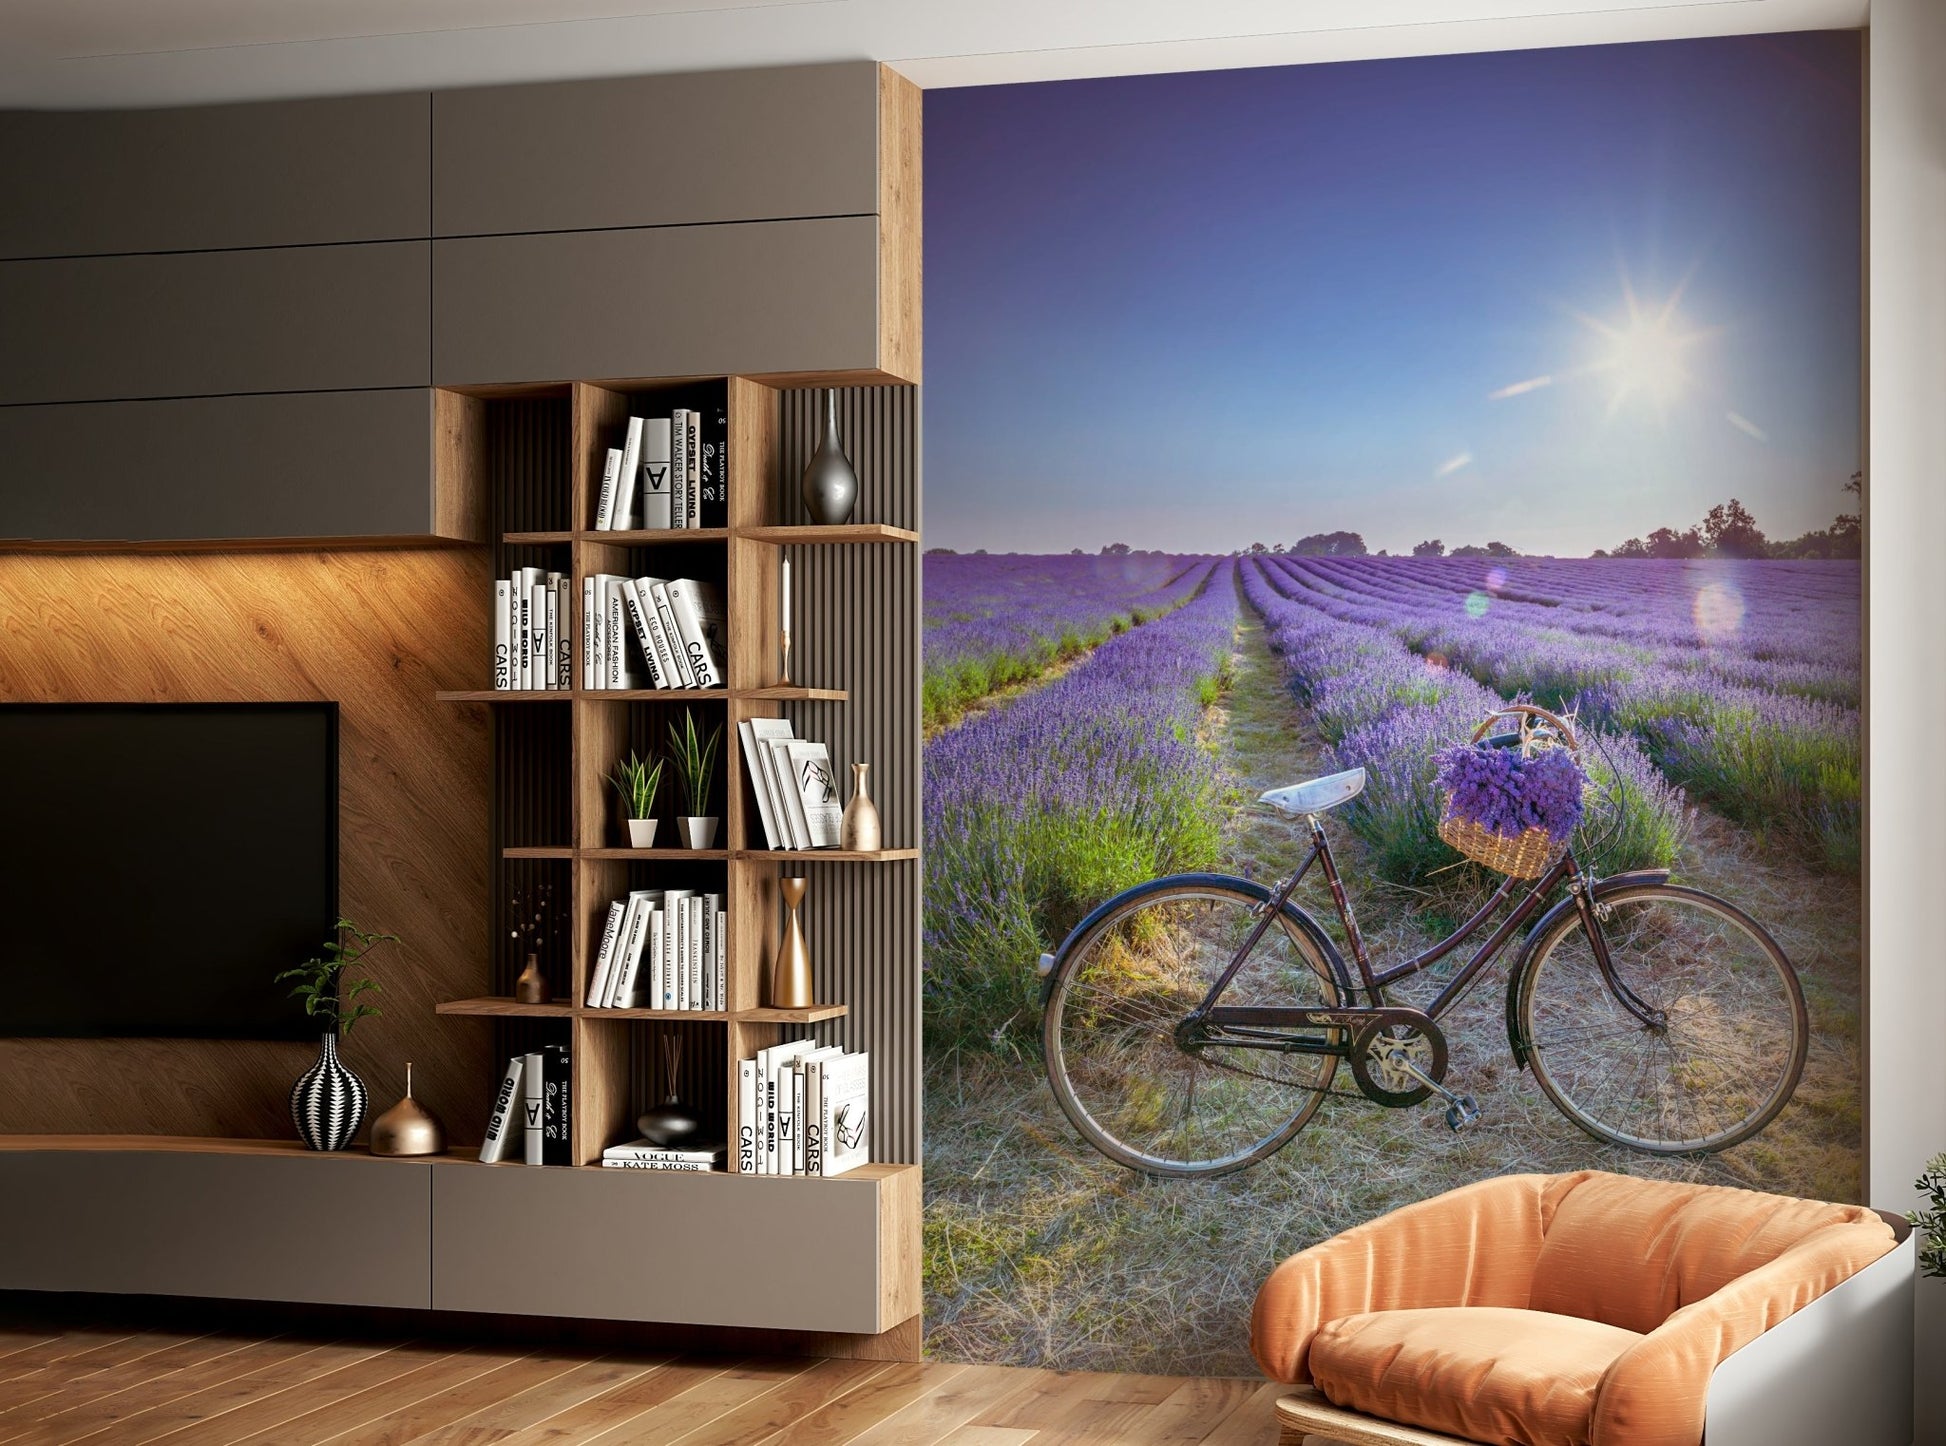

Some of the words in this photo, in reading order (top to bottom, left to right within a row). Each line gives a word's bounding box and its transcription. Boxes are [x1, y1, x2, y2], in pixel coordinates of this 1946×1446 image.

[674, 422, 683, 436] TIM
[674, 438, 683, 472] WALKER
[688, 425, 696, 472] GYPSET
[702, 442, 715, 475] Death
[646, 466, 667, 490] A
[674, 474, 683, 500] STORY
[674, 502, 683, 529] TELLER
[688, 479, 696, 519] LIVING
[533, 633, 544, 653] A
[628, 599, 647, 640] GYPSET
[644, 646, 661, 682] LIVING
[649, 616, 659, 631] ECO
[654, 634, 669, 663] HOUSES
[667, 632, 679, 654] KINFOLK
[676, 654, 684, 670] BOOK
[496, 644, 508, 688] CARS
[560, 639, 571, 686] CARS
[687, 641, 712, 686] CARS
[598, 905, 620, 960] JaneMoore
[486, 1115, 502, 1141] WILD
[496, 1078, 515, 1114] WORLD
[525, 1103, 540, 1126] A
[545, 1081, 557, 1114] Death
[546, 1124, 557, 1139] Co
[779, 1116, 791, 1137] A
[634, 1152, 685, 1162] VOGUE
[741, 1126, 753, 1171] CARS
[807, 1124, 820, 1172] CARS
[623, 1161, 658, 1170] KATE
[662, 1162, 699, 1171] MOSS
